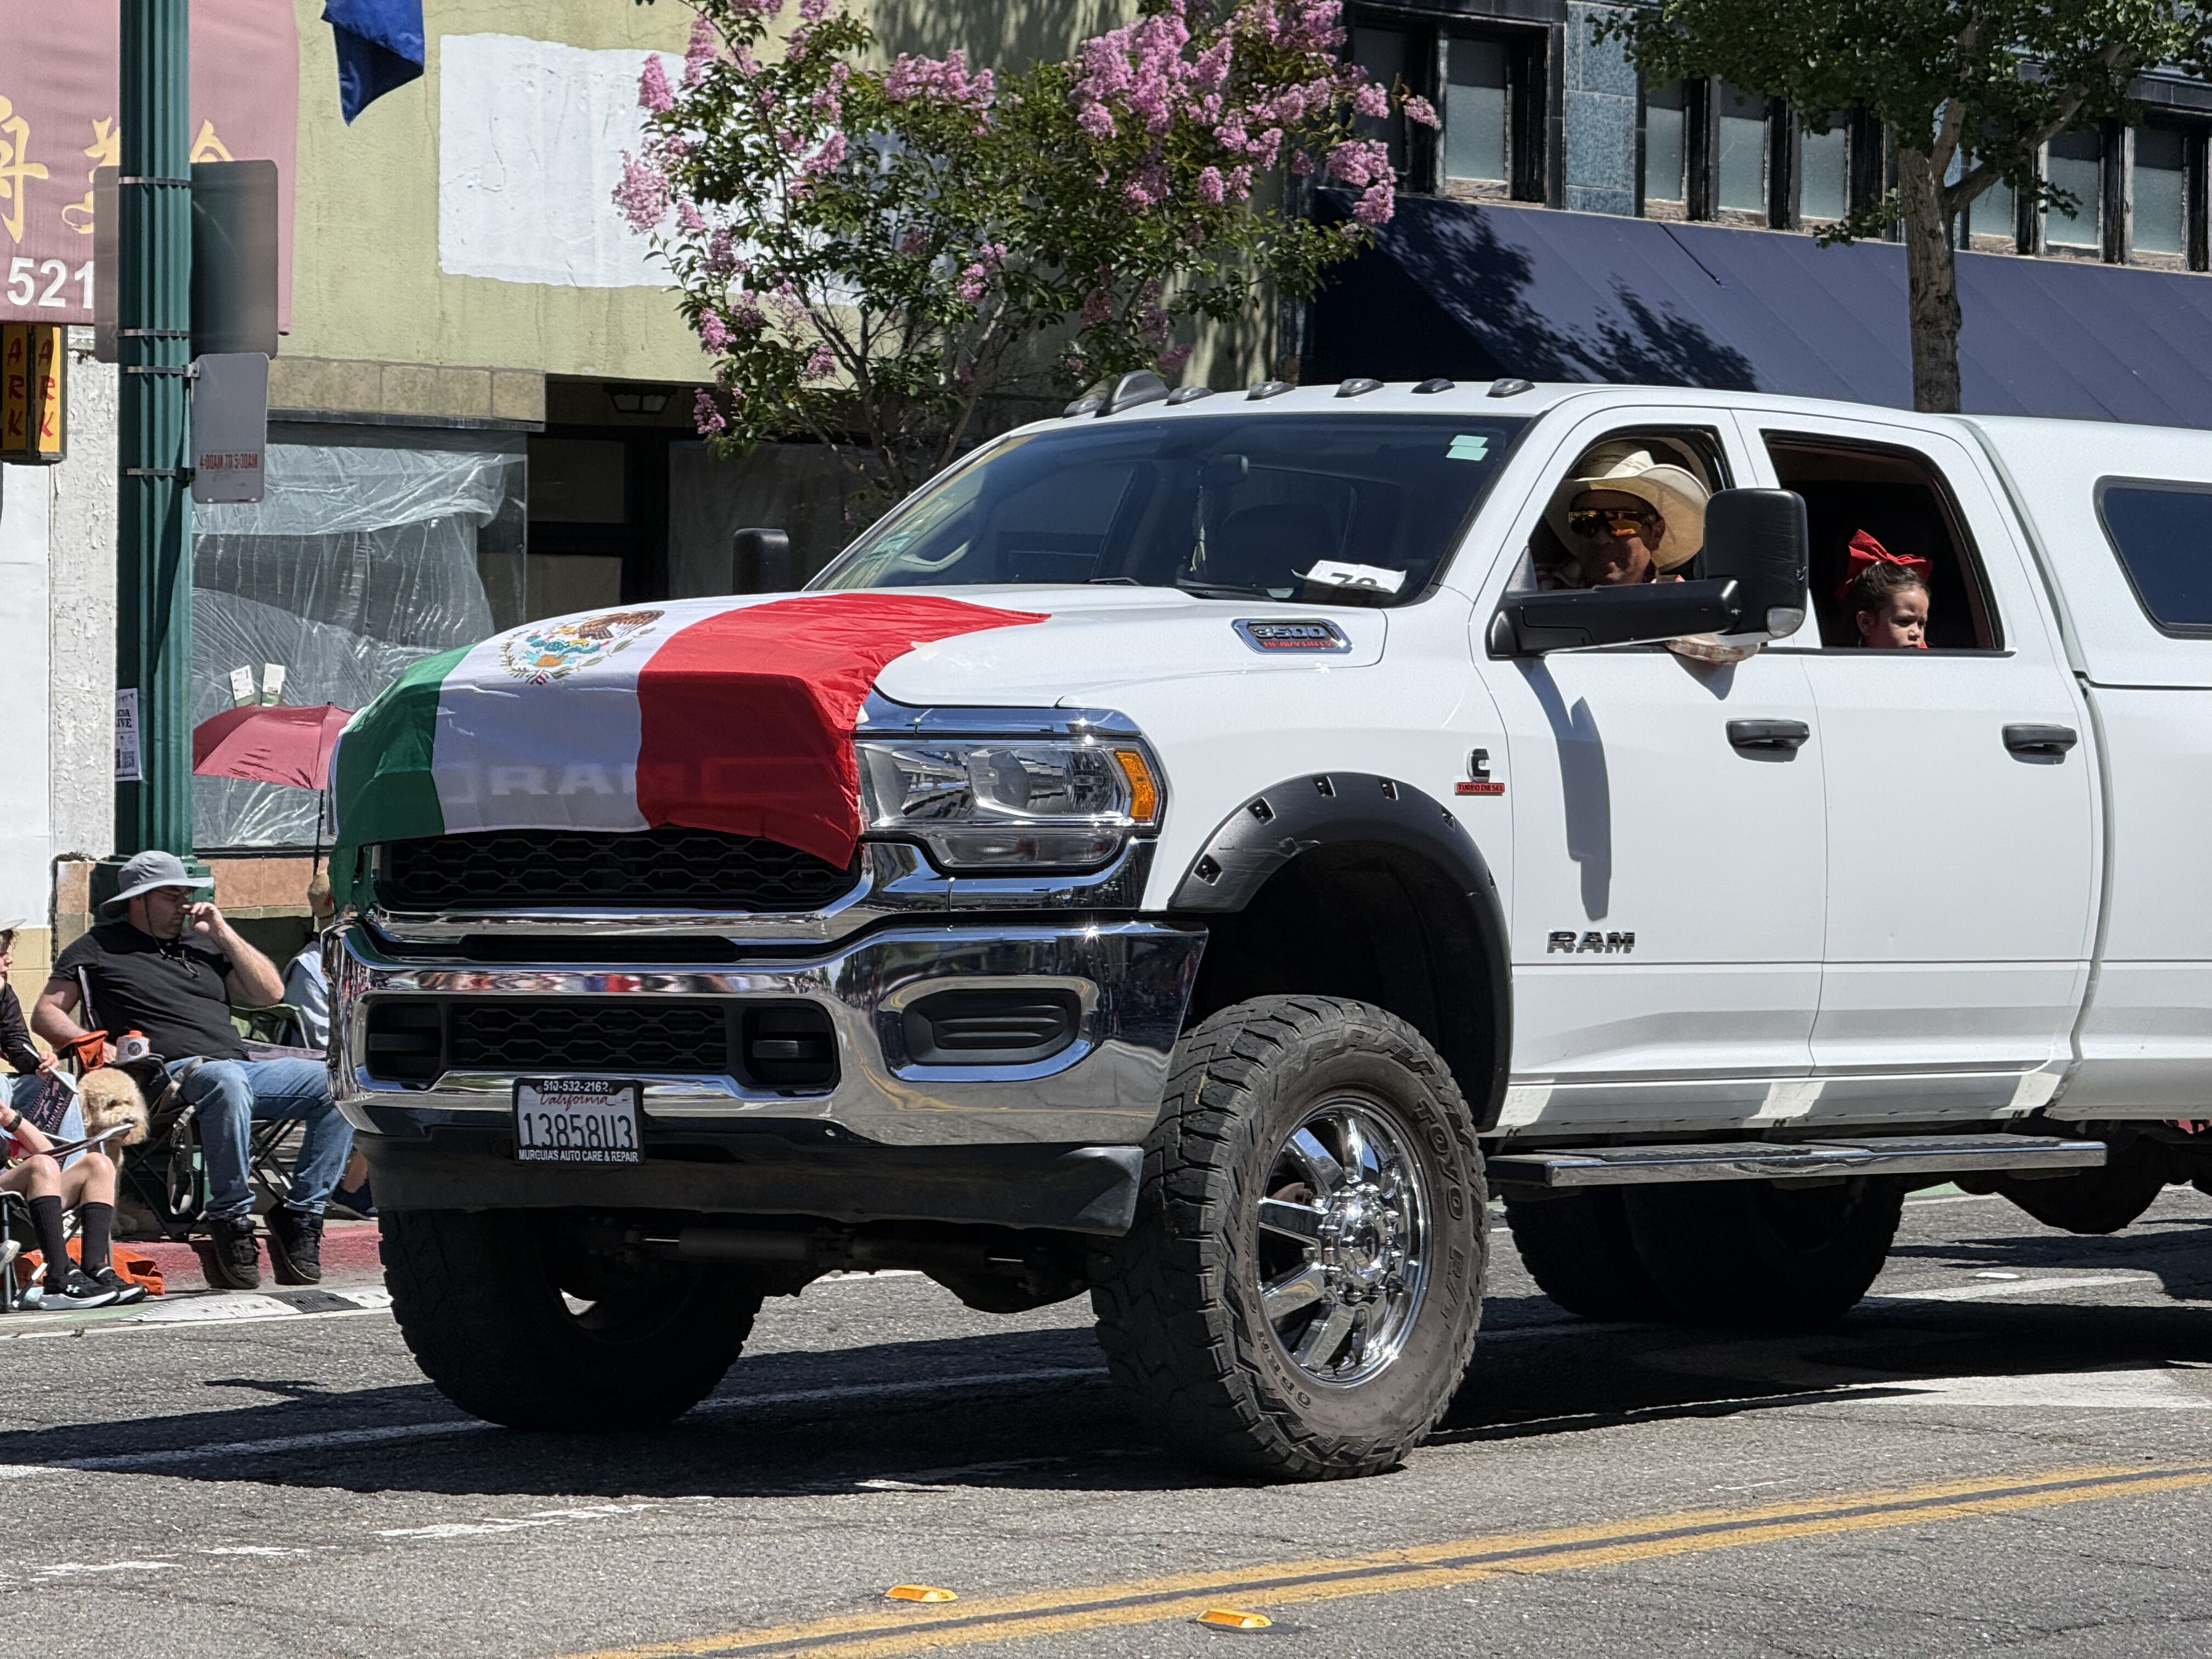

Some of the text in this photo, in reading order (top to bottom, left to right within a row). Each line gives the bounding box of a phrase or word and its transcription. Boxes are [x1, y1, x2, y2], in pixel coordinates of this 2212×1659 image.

[7, 256, 94, 309] 521
[1253, 627, 1327, 639] 3500
[1547, 931, 1635, 954] RAM
[540, 1092, 616, 1111] California
[523, 1113, 634, 1149] 13858U3
[560, 1150, 581, 1161] AUTO
[582, 1150, 603, 1161] CARE
[604, 1152, 610, 1161] &
[611, 1151, 639, 1163] REPAIR
[1415, 1098, 1463, 1220] TOYO
